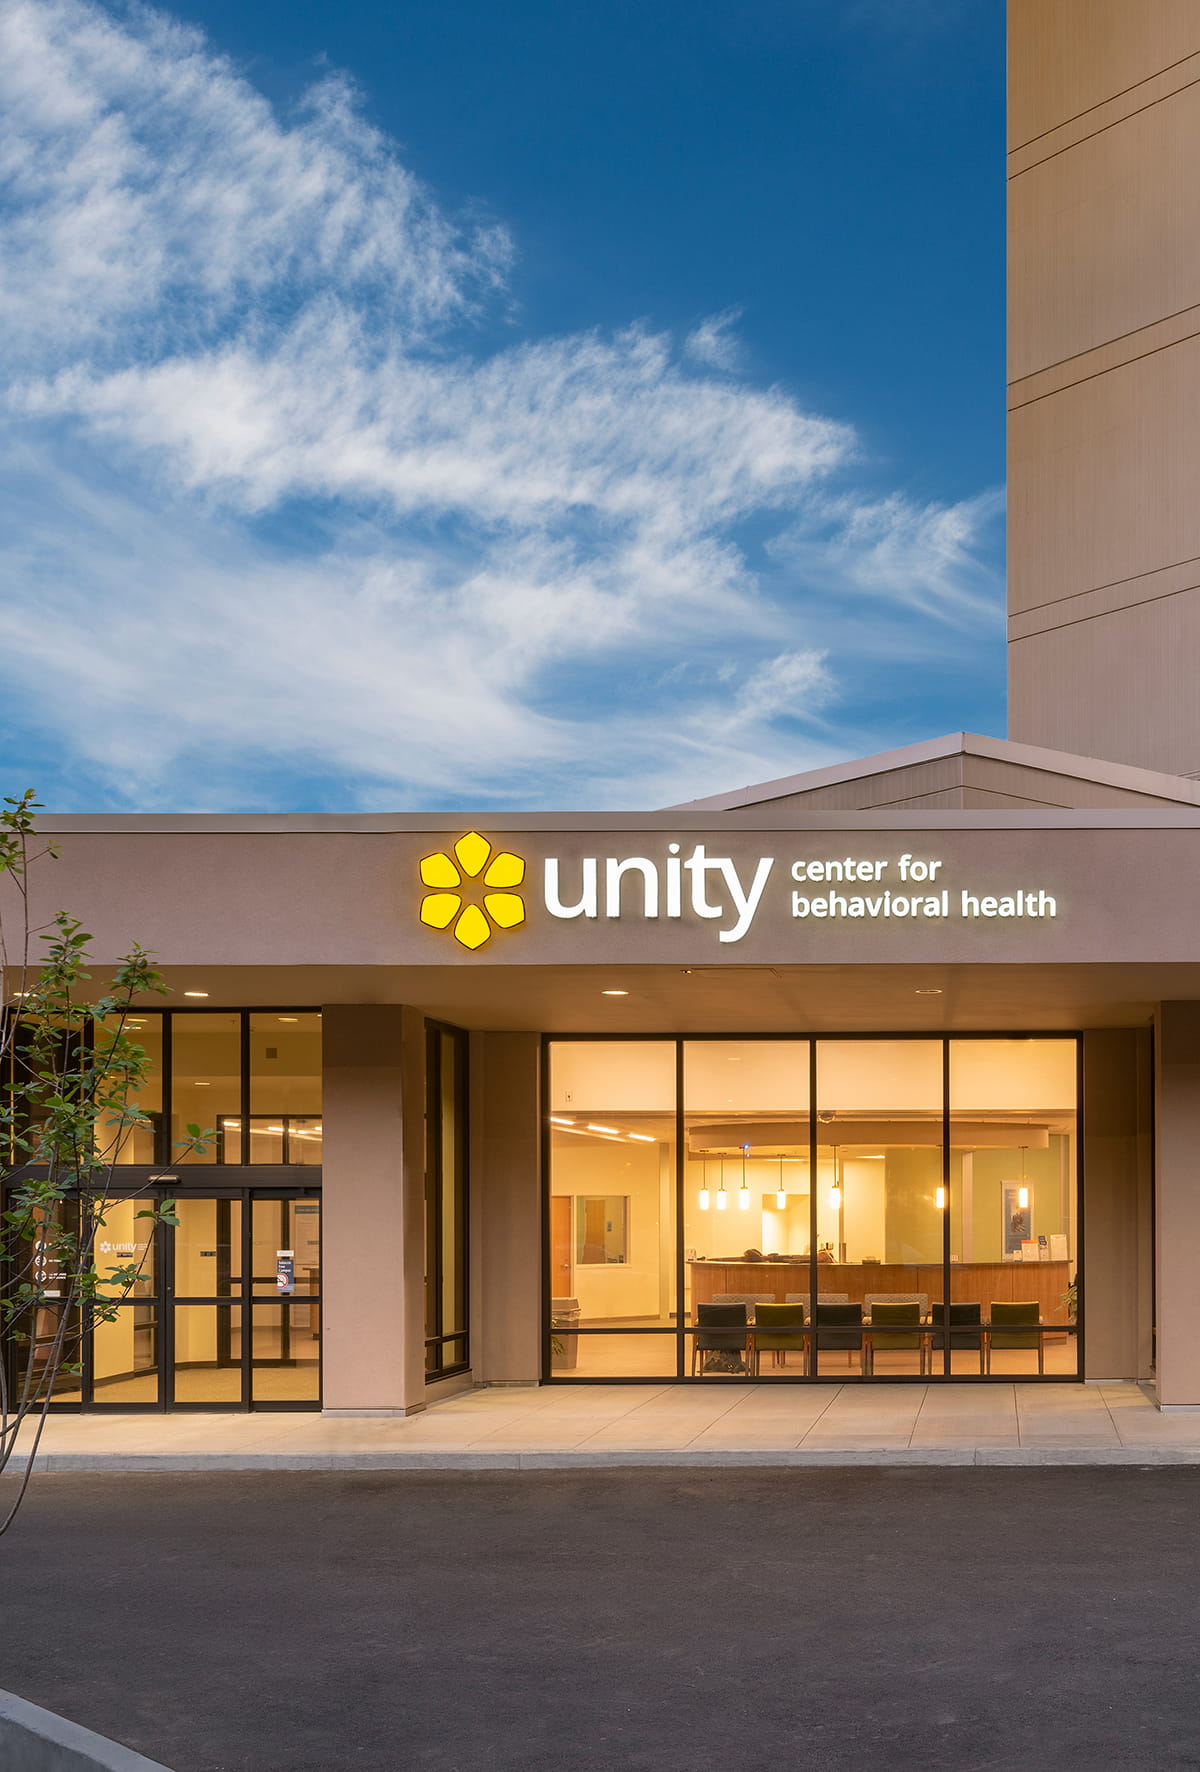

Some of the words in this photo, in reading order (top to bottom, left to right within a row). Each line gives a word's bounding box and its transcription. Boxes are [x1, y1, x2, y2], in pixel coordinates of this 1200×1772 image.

[791, 857, 888, 882] center
[897, 854, 942, 882] for
[544, 843, 774, 943] unity
[792, 890, 949, 918] behavioral
[961, 890, 1057, 918] health
[112, 1242, 137, 1253] unity
